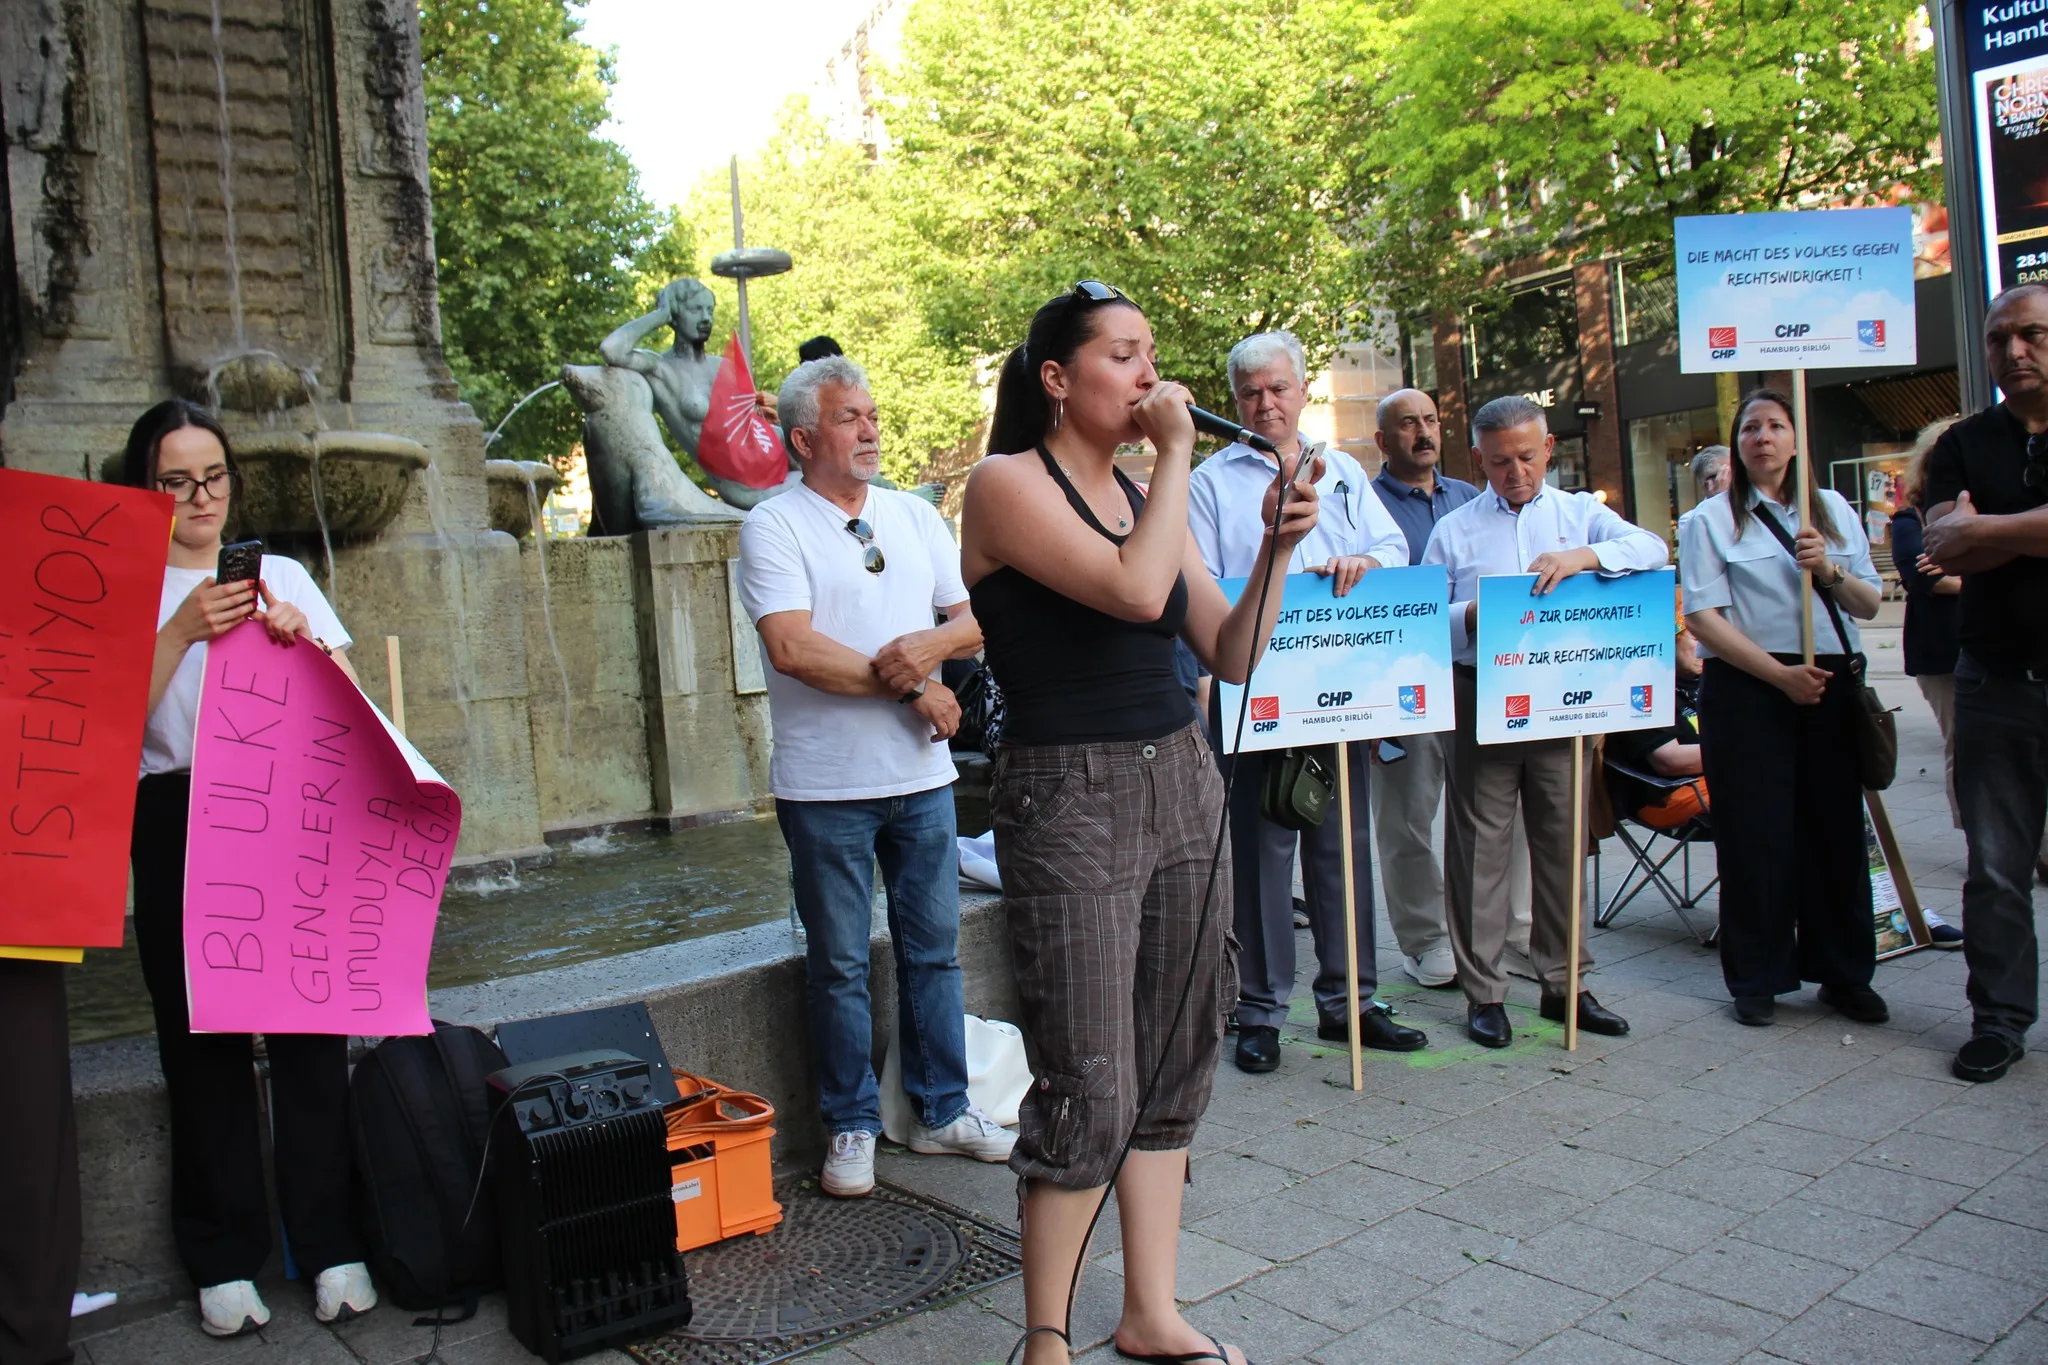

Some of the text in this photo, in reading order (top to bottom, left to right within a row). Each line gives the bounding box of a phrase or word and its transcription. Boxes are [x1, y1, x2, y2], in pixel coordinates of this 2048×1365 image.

[1983, 0, 2048, 27] Kultu
[1996, 106, 2046, 127] & BAND
[2004, 121, 2034, 135] TOUR
[1687, 242, 1900, 264] DIE MACHT DES VOLKES GEGEN
[2016, 251, 2048, 268] 28.1
[1727, 267, 1855, 287] RECHTSWIDRIGKEIT
[1775, 324, 1811, 338] CHP
[1711, 349, 1736, 360] CHP
[1760, 345, 1800, 354] HAMBURG
[1277, 602, 1438, 624] CHT DES VOLKES GEGEN
[1520, 610, 1535, 624] JA
[1539, 609, 1561, 623] ZUR
[1564, 605, 1634, 621] DEMOKRATIE
[1269, 630, 1395, 652] RECHTSWIDRIGKEIT
[1494, 653, 1525, 666] NEIN
[1528, 652, 1551, 665] ZUR
[1554, 644, 1657, 663] RECHTSWIDRIGKEIT
[1317, 691, 1352, 707] CHP
[1562, 691, 1593, 706] CHP
[1302, 715, 1342, 725] HAMBURG
[1507, 718, 1529, 729] CHP
[1549, 713, 1583, 722] HAMBURG
[1253, 721, 1278, 732] CHP
[202, 660, 289, 973] BU ÜLKE
[346, 798, 402, 1011] UMUDUYLA
[672, 1181, 699, 1192] tromkabel
